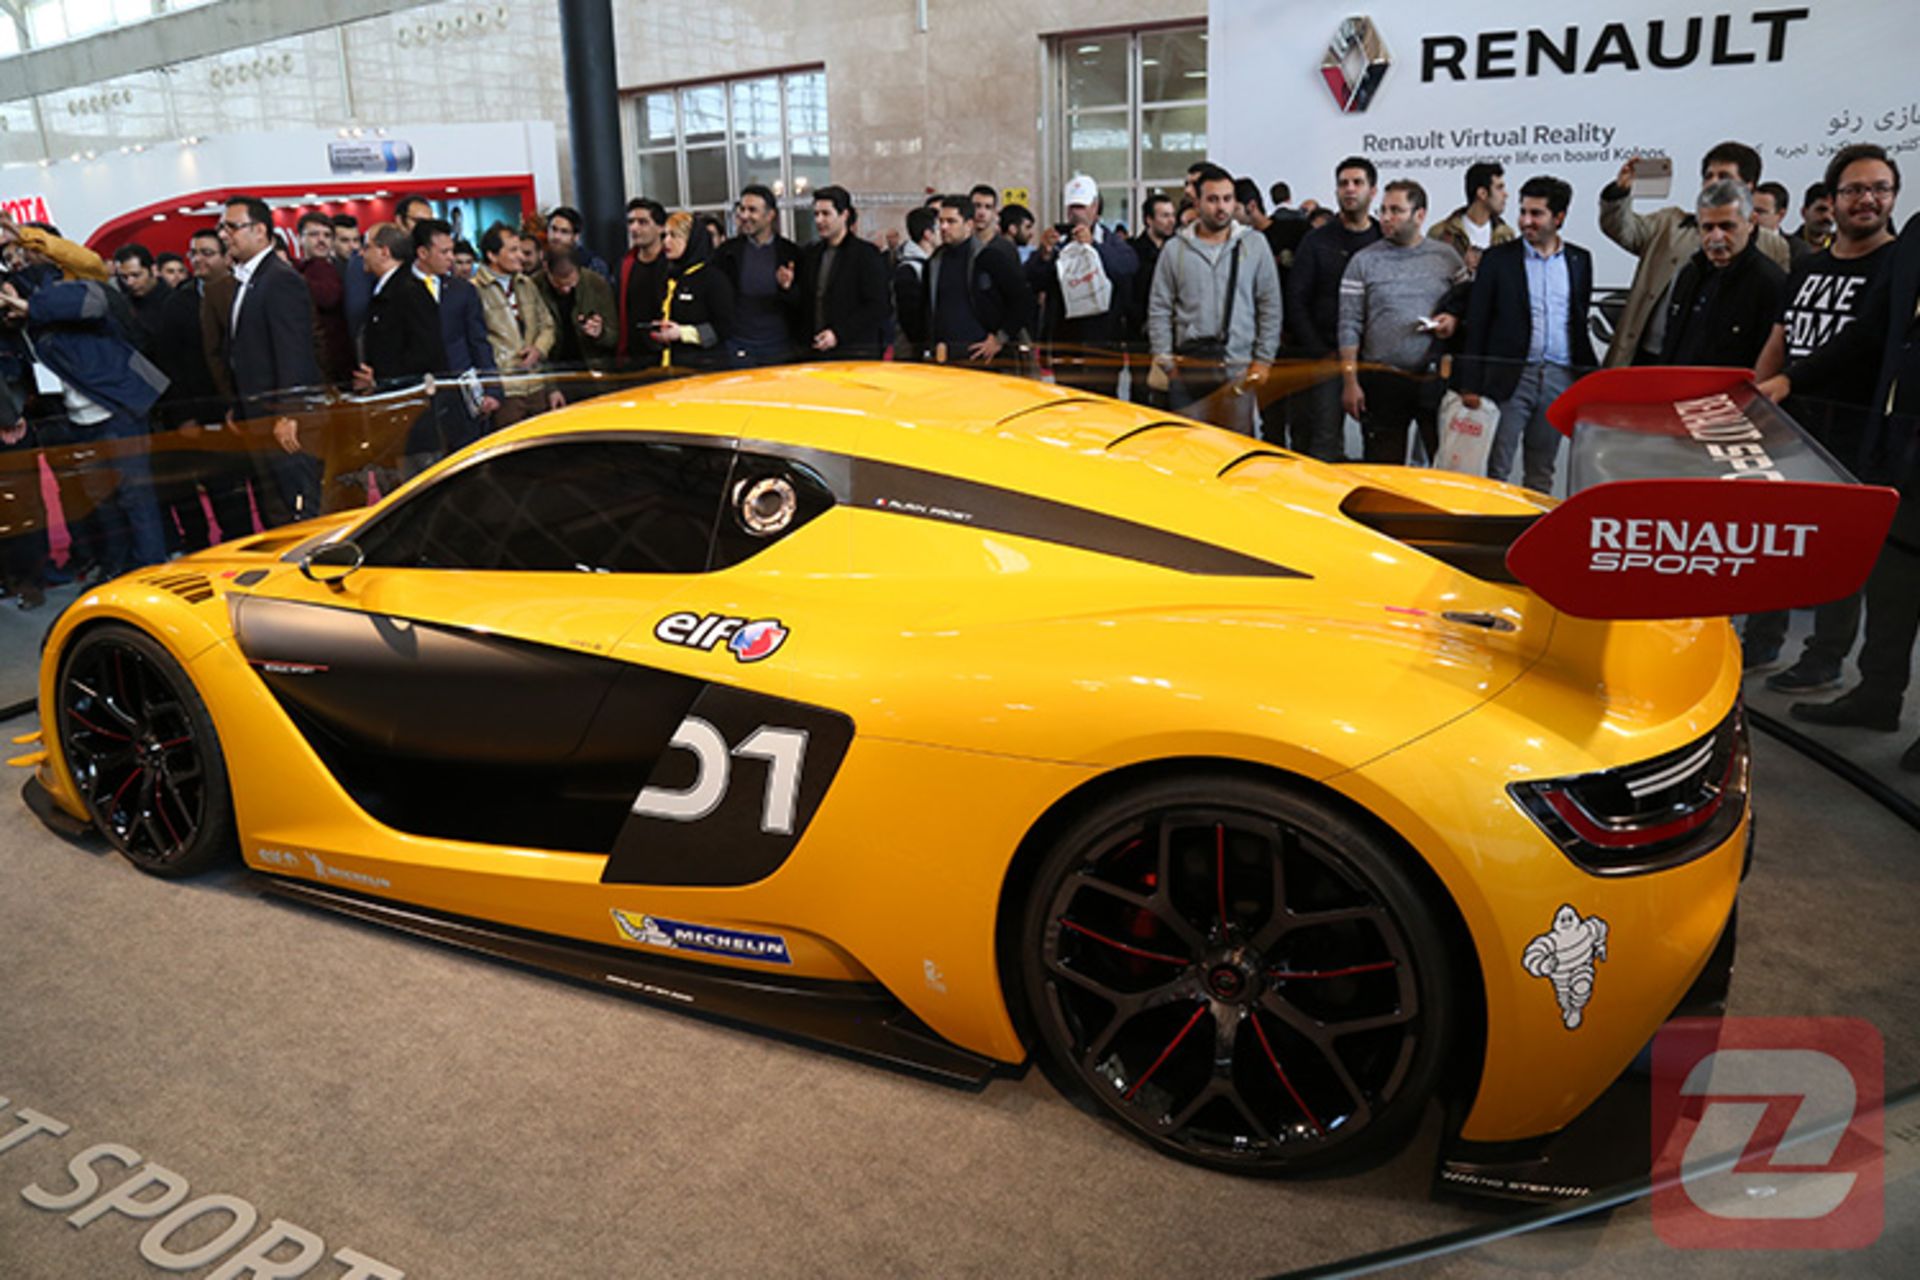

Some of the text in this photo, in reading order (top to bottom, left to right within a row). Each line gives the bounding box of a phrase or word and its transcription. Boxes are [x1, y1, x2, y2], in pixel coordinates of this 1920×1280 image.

[1421, 8, 1809, 82] RENAULT
[1364, 122, 1615, 151] Renault Virtual Reality
[1827, 109, 1863, 136] رنو
[1404, 156, 1431, 168] and
[1515, 150, 1538, 164] life
[1541, 151, 1561, 163] on
[1564, 148, 1609, 162] board
[1793, 273, 1866, 310] AWE
[1590, 517, 1819, 557] RENAULT
[1589, 552, 1757, 576] SPORT
[655, 612, 747, 650] elf
[675, 928, 784, 954] MICHELIN
